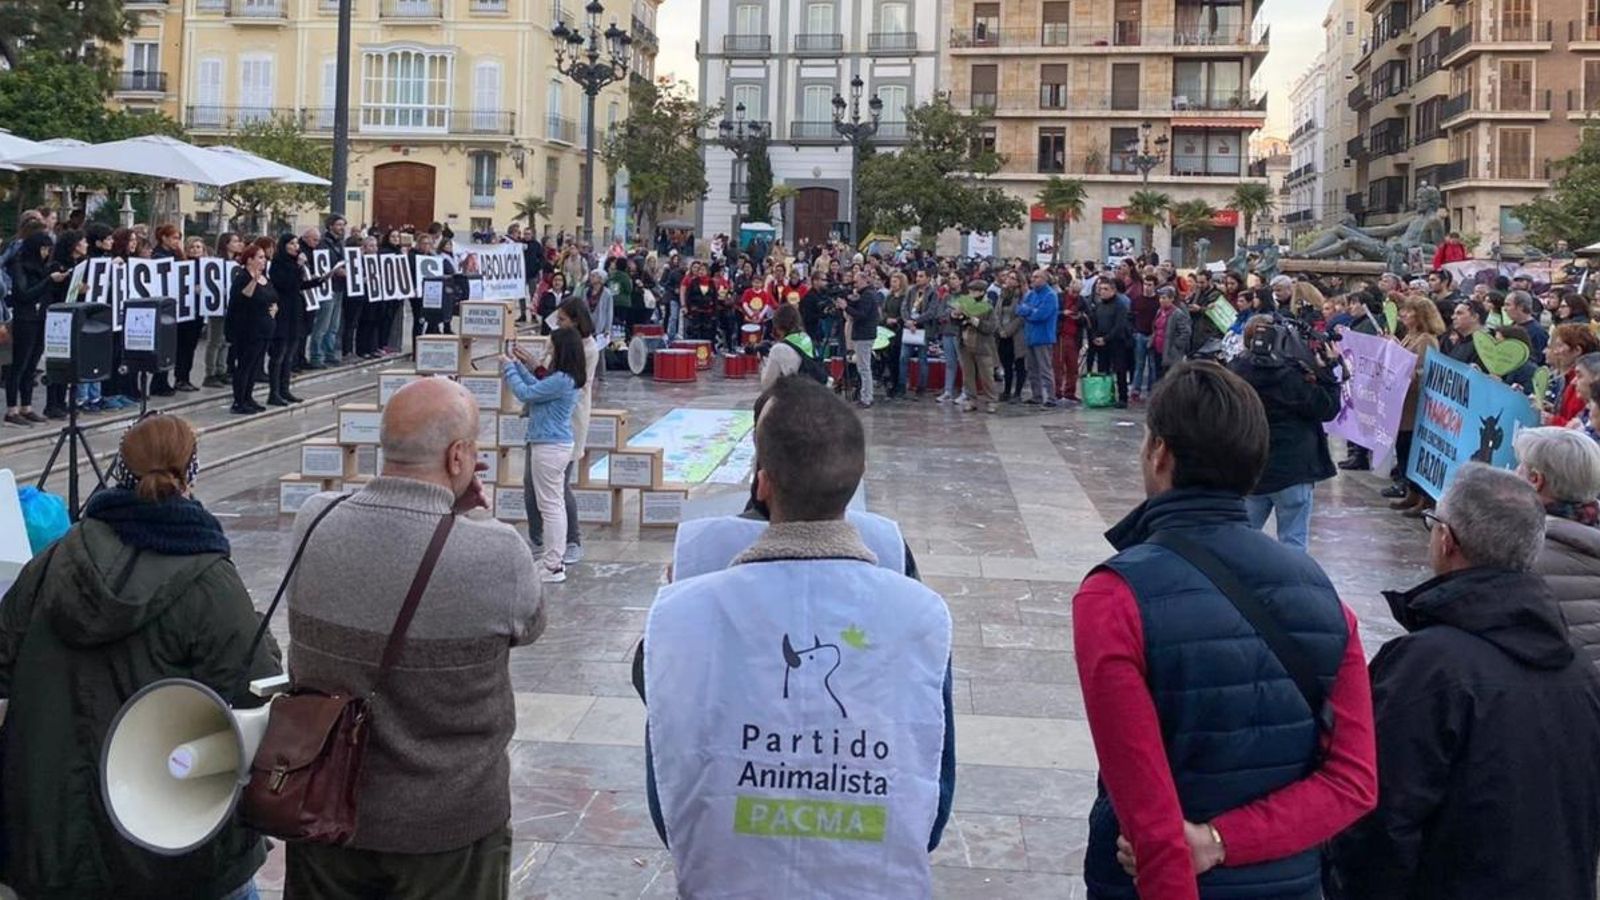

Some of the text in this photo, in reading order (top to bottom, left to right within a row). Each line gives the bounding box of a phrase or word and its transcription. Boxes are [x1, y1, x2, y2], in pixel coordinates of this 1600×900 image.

[1425, 360, 1470, 408] NINGUNA
[742, 724, 889, 759] Partido
[737, 761, 888, 795] Animalista
[750, 804, 864, 833] PACMA
